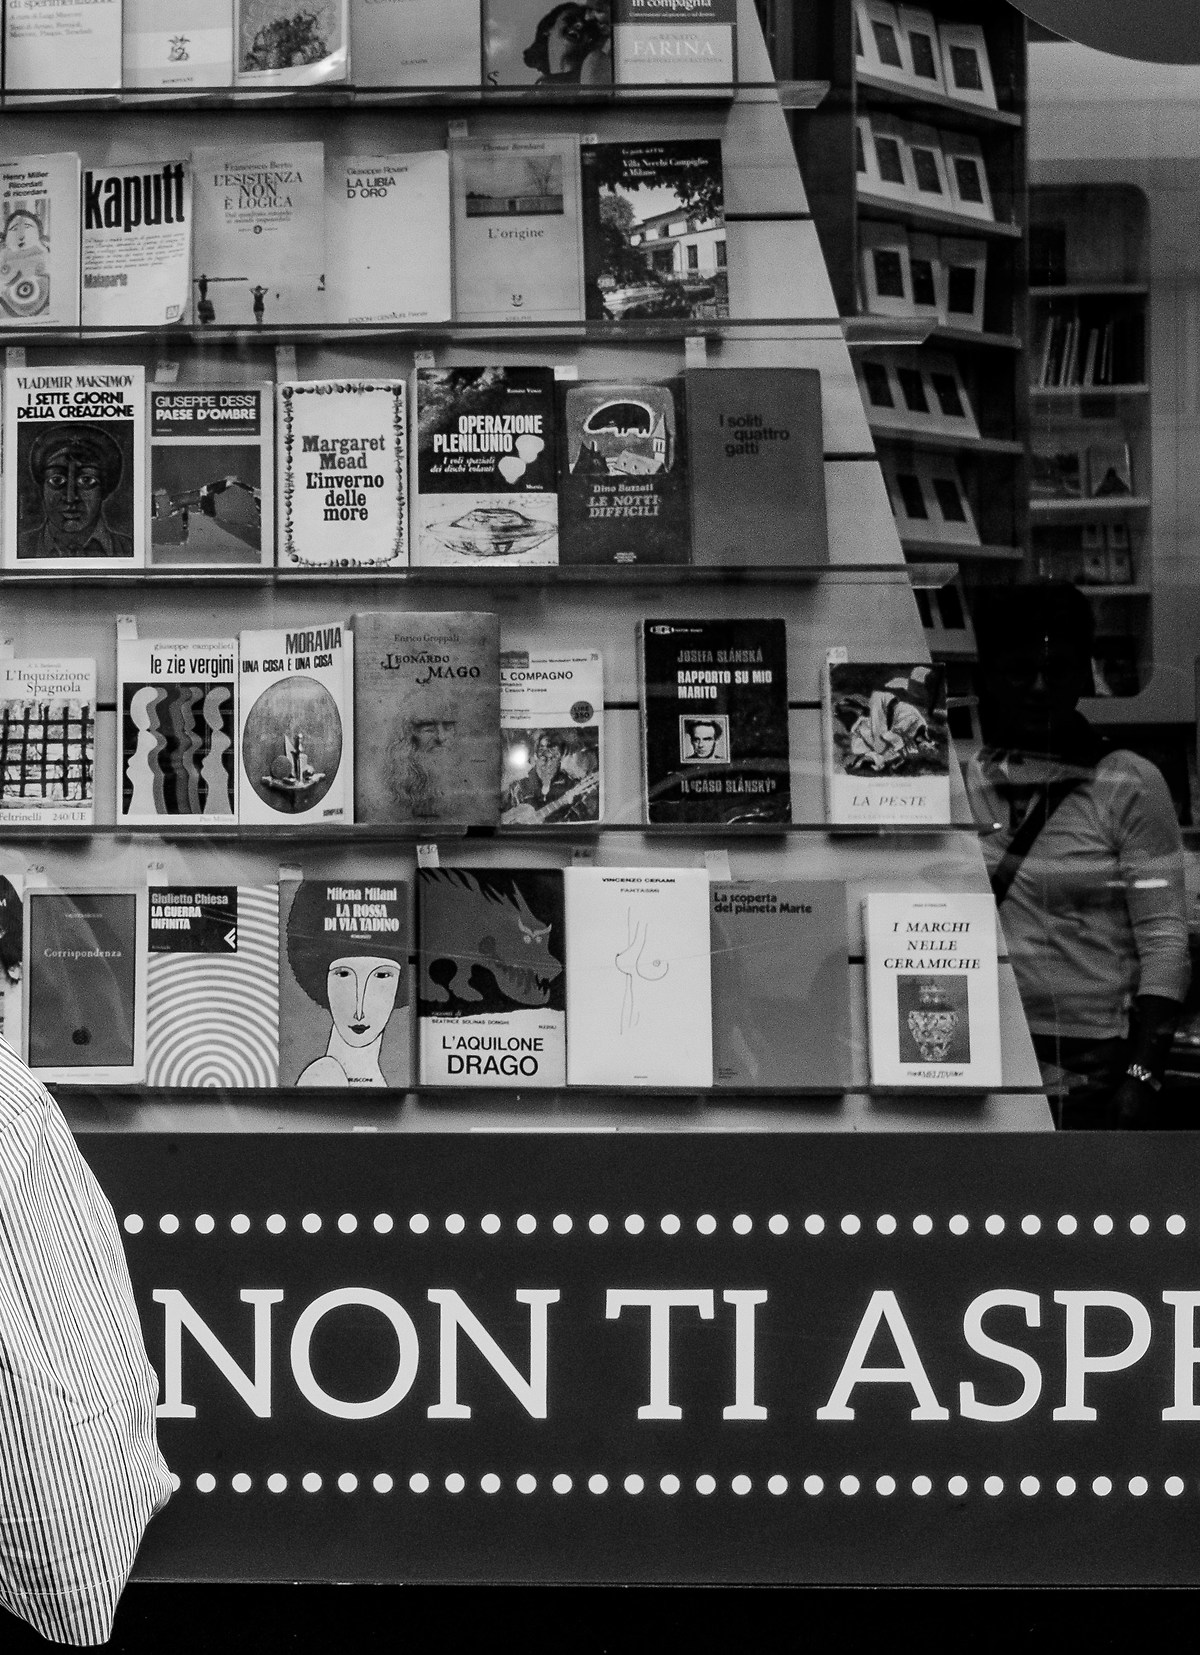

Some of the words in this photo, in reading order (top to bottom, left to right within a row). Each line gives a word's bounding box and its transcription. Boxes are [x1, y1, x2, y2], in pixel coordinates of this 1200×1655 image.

[632, 40, 714, 56] FARINA
[213, 171, 303, 187] L'ESISTENZA
[346, 178, 363, 188] LA
[366, 177, 396, 187] LIBIA
[239, 183, 277, 197] NON
[85, 163, 185, 232] kaputt
[238, 196, 293, 209] LOGICA
[488, 227, 544, 241] L'origine
[17, 376, 72, 389] VLADIMIR
[75, 375, 135, 387] MAKSIMOV
[27, 393, 32, 406] I
[35, 393, 70, 406] SETTE
[73, 391, 124, 405] GIORNI
[155, 395, 216, 408] GIUSEPPE
[17, 406, 55, 419] DELLA
[58, 404, 135, 418] CREAZIONE
[155, 409, 194, 420] PAESE
[197, 408, 256, 420] D'OMBRE
[458, 415, 544, 434] OPERAZIONE
[719, 414, 724, 427] I
[727, 413, 763, 428] soliti
[734, 427, 790, 443] quattro
[302, 434, 386, 454] Margaret
[433, 433, 513, 453] PLENILUNIO
[725, 441, 759, 457] gatti
[319, 453, 368, 470] Mead
[305, 471, 385, 489] L'inverno
[593, 484, 616, 493] Dino
[618, 483, 654, 492] Buzzati
[324, 489, 367, 507] delle
[586, 496, 608, 507] LE
[613, 494, 660, 506] NOTTI
[323, 506, 369, 521] more
[588, 505, 659, 518] DIFFICILI
[285, 627, 342, 655] MORAVIA
[394, 633, 422, 642] Enrico
[423, 634, 459, 645] Groppali
[192, 643, 234, 651] campolieti
[677, 650, 714, 663] JOSEFA
[717, 647, 764, 663] SLÁNSKÁ
[150, 654, 162, 674] le
[166, 653, 186, 674] zie
[189, 653, 234, 678] vergini
[242, 660, 259, 673] UNA
[262, 659, 284, 672] COSA
[295, 656, 311, 670] UNA
[313, 653, 333, 669] COSA
[5, 669, 91, 685] L'Inquisizione
[415, 665, 481, 685] MAGO
[509, 670, 574, 681] COMPAGNO
[677, 670, 731, 684] RAPPORTO
[734, 670, 749, 684] SU
[752, 670, 773, 684] MIO
[26, 682, 81, 697] Spagnola
[677, 685, 718, 699] MARITO
[680, 780, 690, 793] IL
[852, 796, 870, 806] LA
[879, 795, 927, 806] PESTE
[151, 893, 193, 905] Giulietto
[194, 893, 229, 905] Chiesa
[326, 887, 362, 901] Milena
[364, 887, 397, 901] Milani
[713, 892, 728, 903] La
[730, 893, 778, 905] scoperta
[151, 905, 163, 918] LA
[163, 905, 202, 918] GUERRA
[336, 903, 350, 918] LA
[352, 903, 388, 918] ROSSA
[713, 902, 733, 913] del
[734, 902, 777, 915] pianeta
[779, 902, 813, 914] Marte
[151, 918, 191, 930] INFINITA
[324, 917, 337, 931] DI
[338, 917, 358, 931] VIA
[358, 917, 400, 932] TADINO
[893, 922, 899, 933] I
[906, 922, 971, 933] MARCHI
[907, 940, 958, 951] NELLE
[43, 947, 122, 961] Corrispondenza
[883, 958, 981, 969] CERAMICHE
[442, 1036, 544, 1052] L'AQUILONE
[447, 1055, 539, 1076] DRAGO
[152, 1285, 561, 1421] NON
[604, 1287, 769, 1421] TI
